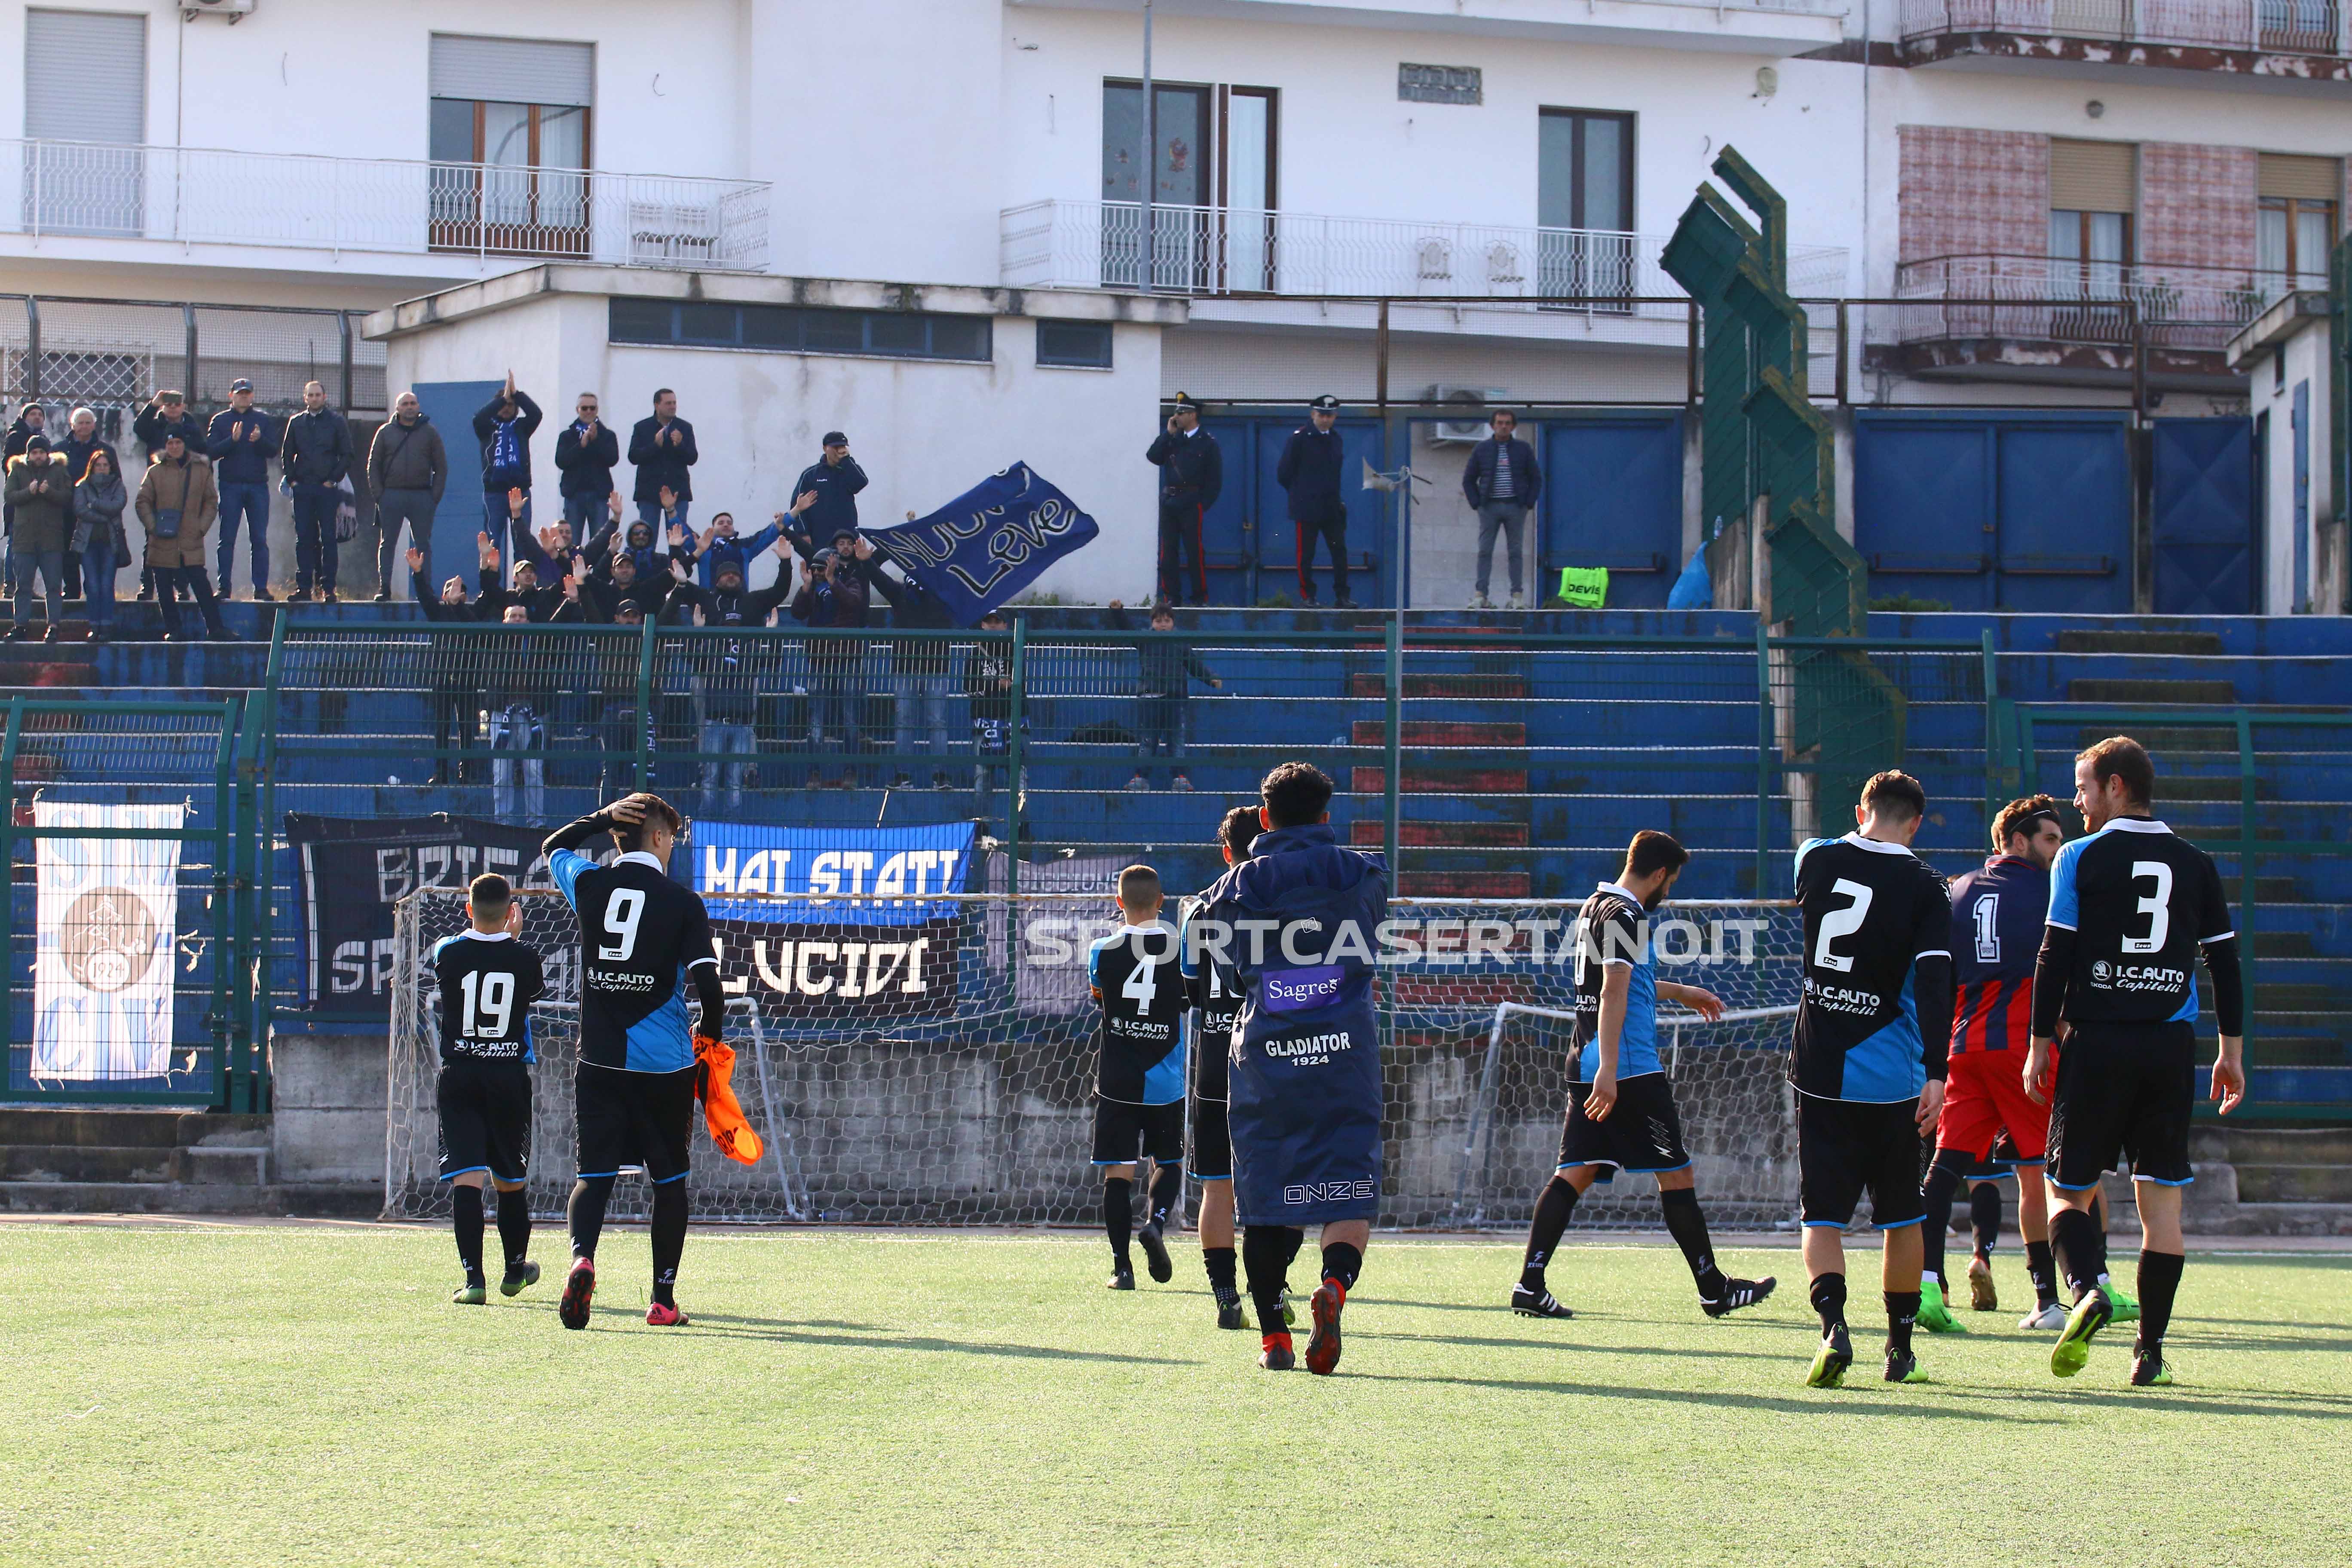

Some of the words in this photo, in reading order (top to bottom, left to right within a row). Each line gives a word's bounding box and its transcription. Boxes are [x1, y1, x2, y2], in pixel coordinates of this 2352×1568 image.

[705, 845, 790, 904] MAI
[2122, 861, 2172, 953] 3
[598, 888, 646, 961] 9
[1814, 877, 1873, 973] 2
[1972, 893, 2000, 963] 1
[597, 971, 655, 984] I.C.AUTO
[711, 937, 928, 997] LUCIDI
[2116, 965, 2184, 983] I.C.AUTO
[601, 982, 652, 992] Capitelli
[1121, 955, 1157, 1016] 4
[1269, 979, 1338, 1004] Sagres
[1816, 984, 1880, 1007] I.C.AUTO
[2090, 982, 2112, 990] SKODA
[2116, 979, 2181, 993] Capitelli
[461, 970, 515, 1038] 19
[1818, 998, 1877, 1016] Capitelli
[1125, 1021, 1169, 1033] I.C.AUTO
[1126, 1030, 1168, 1040] Capitelli
[1265, 1032, 1351, 1058] GLADIATOR
[1291, 1055, 1329, 1067] 1924
